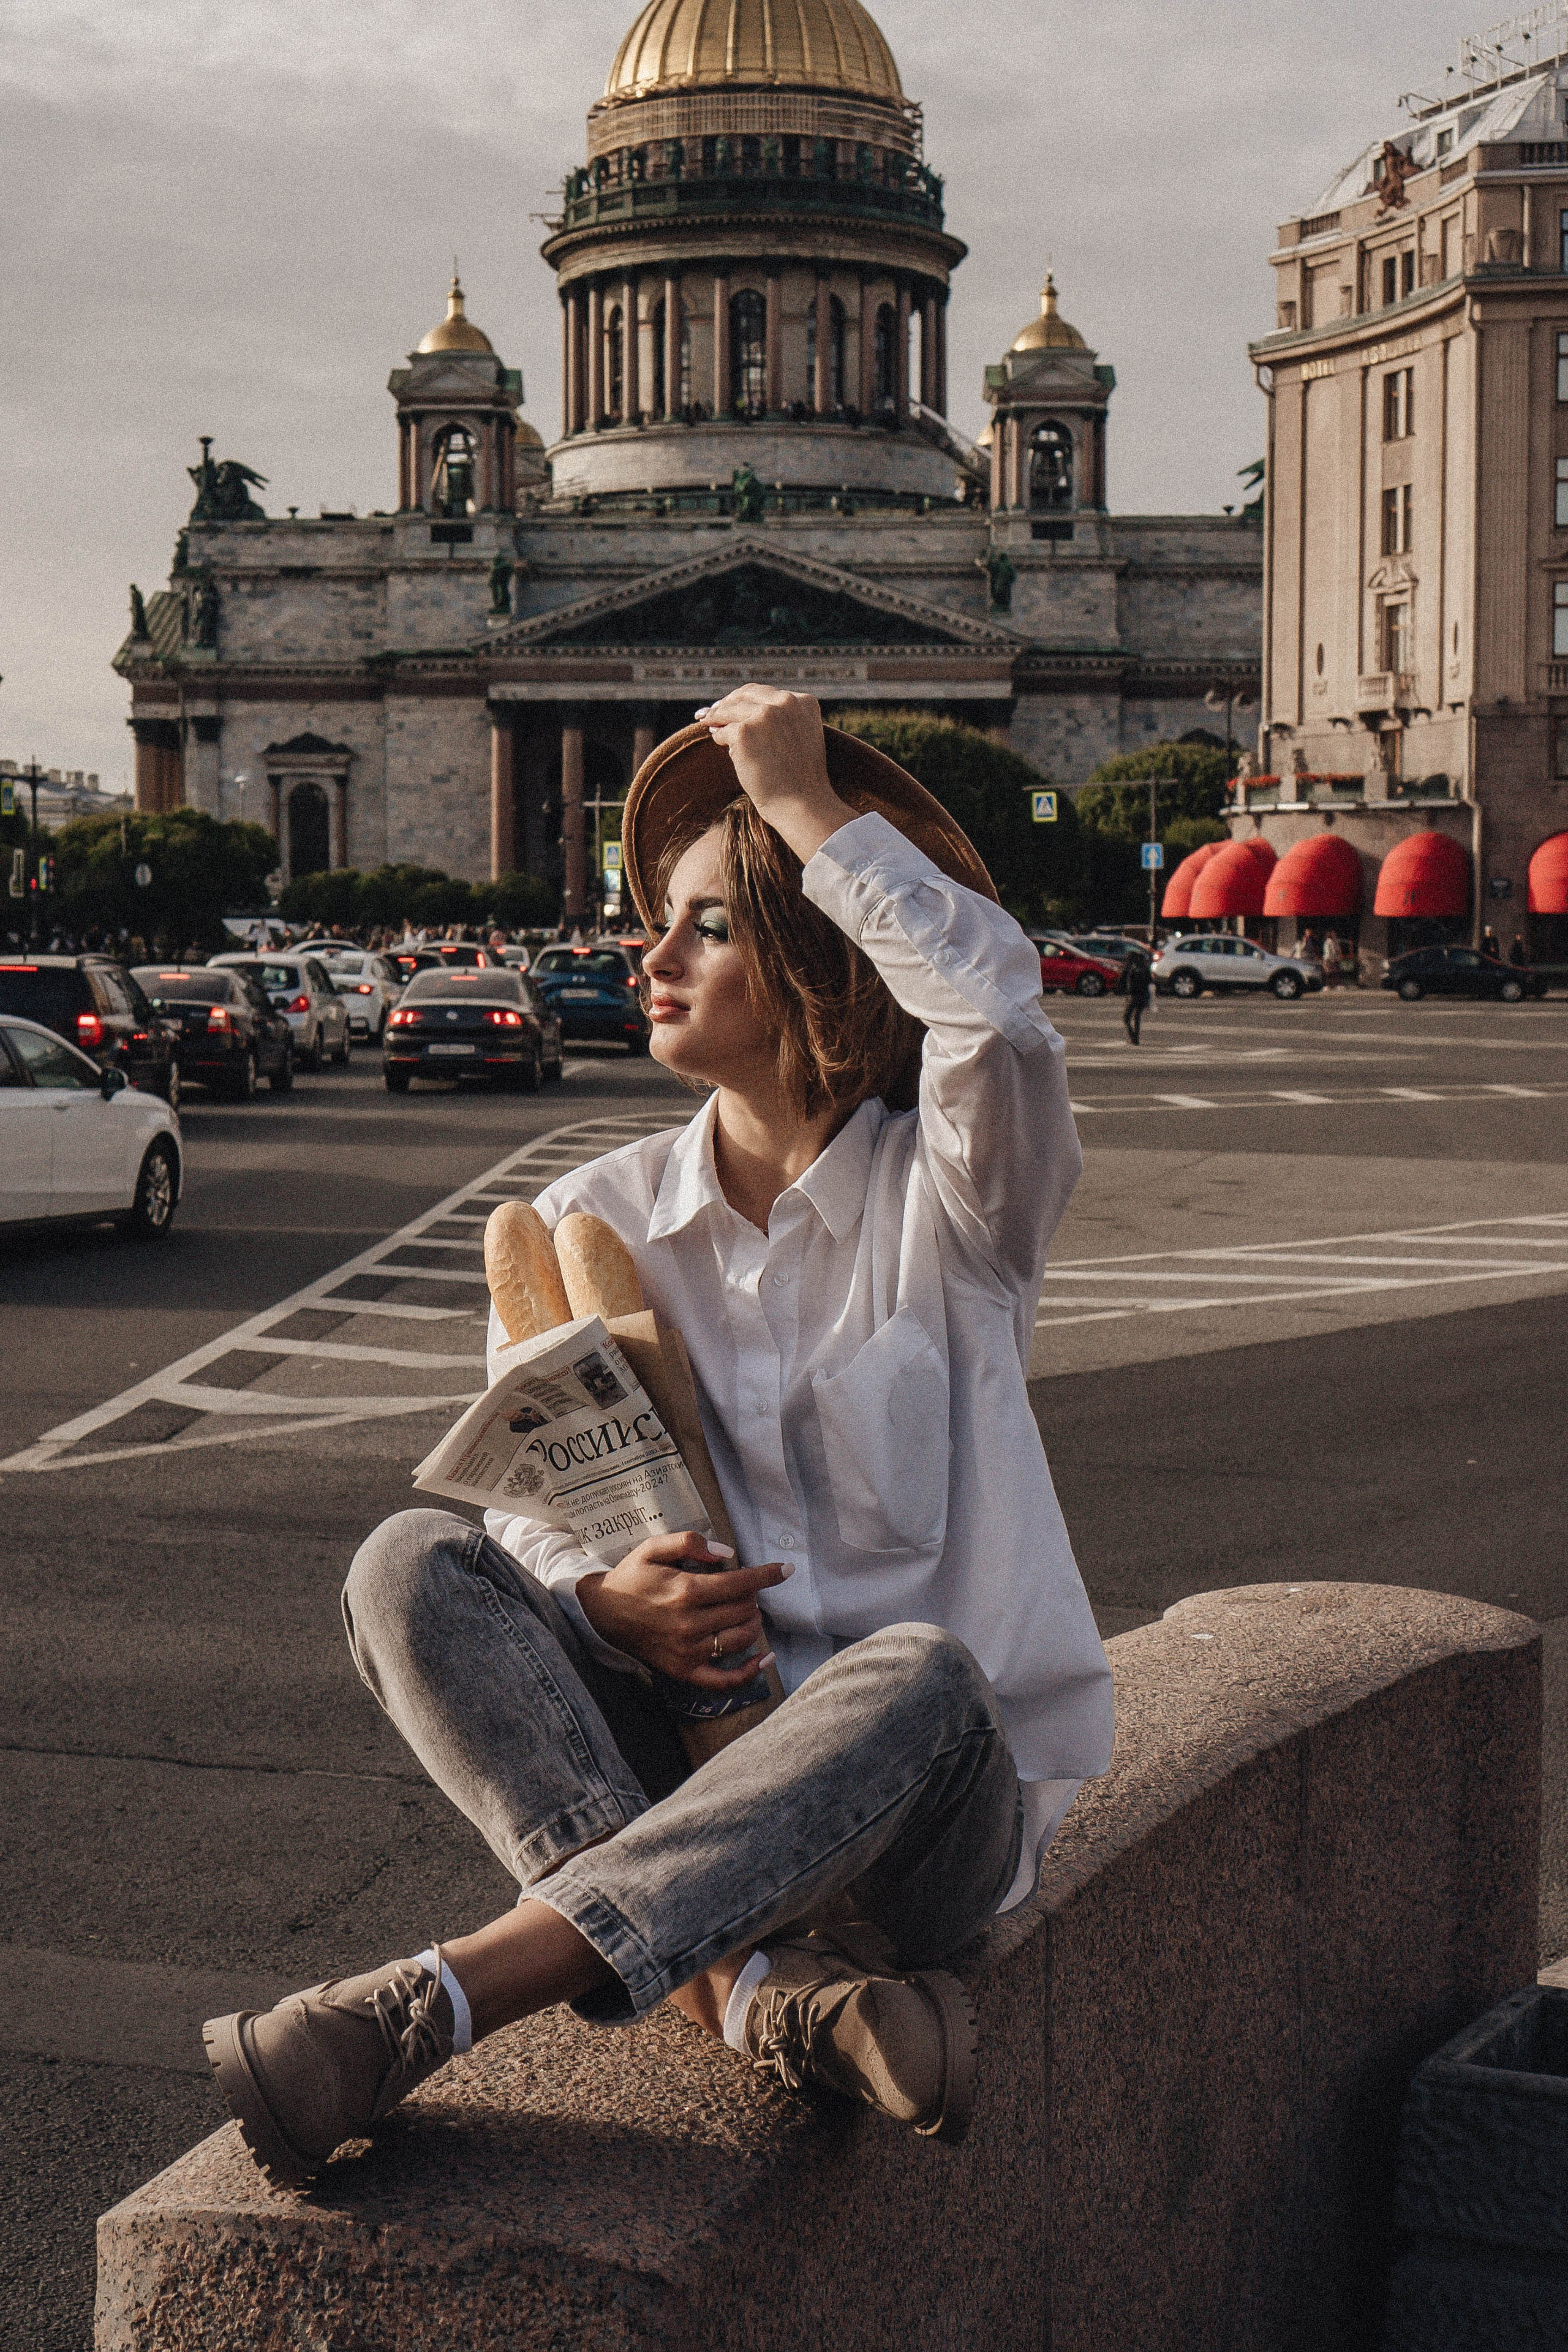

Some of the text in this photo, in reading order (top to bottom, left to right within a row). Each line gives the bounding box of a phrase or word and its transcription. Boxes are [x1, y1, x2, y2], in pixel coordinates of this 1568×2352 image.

[571, 1498, 580, 1507] не
[632, 1474, 643, 1484] на
[575, 1501, 604, 1517] попасть
